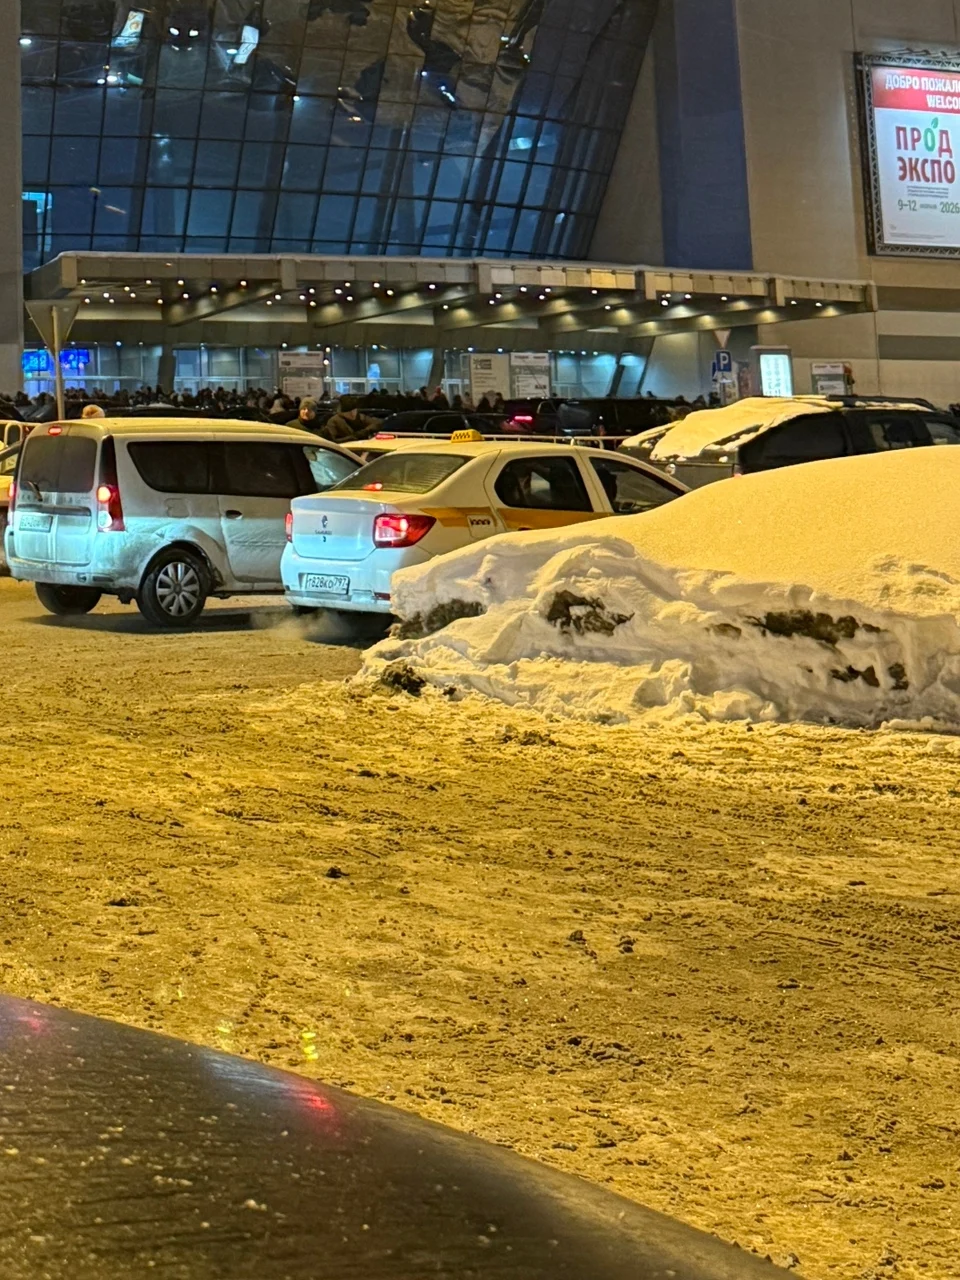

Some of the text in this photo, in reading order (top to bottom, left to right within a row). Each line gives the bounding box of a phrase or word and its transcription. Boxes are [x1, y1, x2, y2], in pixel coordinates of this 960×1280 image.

[885, 74, 920, 90] ДОБРО
[926, 94, 960, 110] WELCO
[895, 125, 953, 159] ПРОД
[897, 156, 955, 184] ЭКСПО
[720, 353, 729, 370] P
